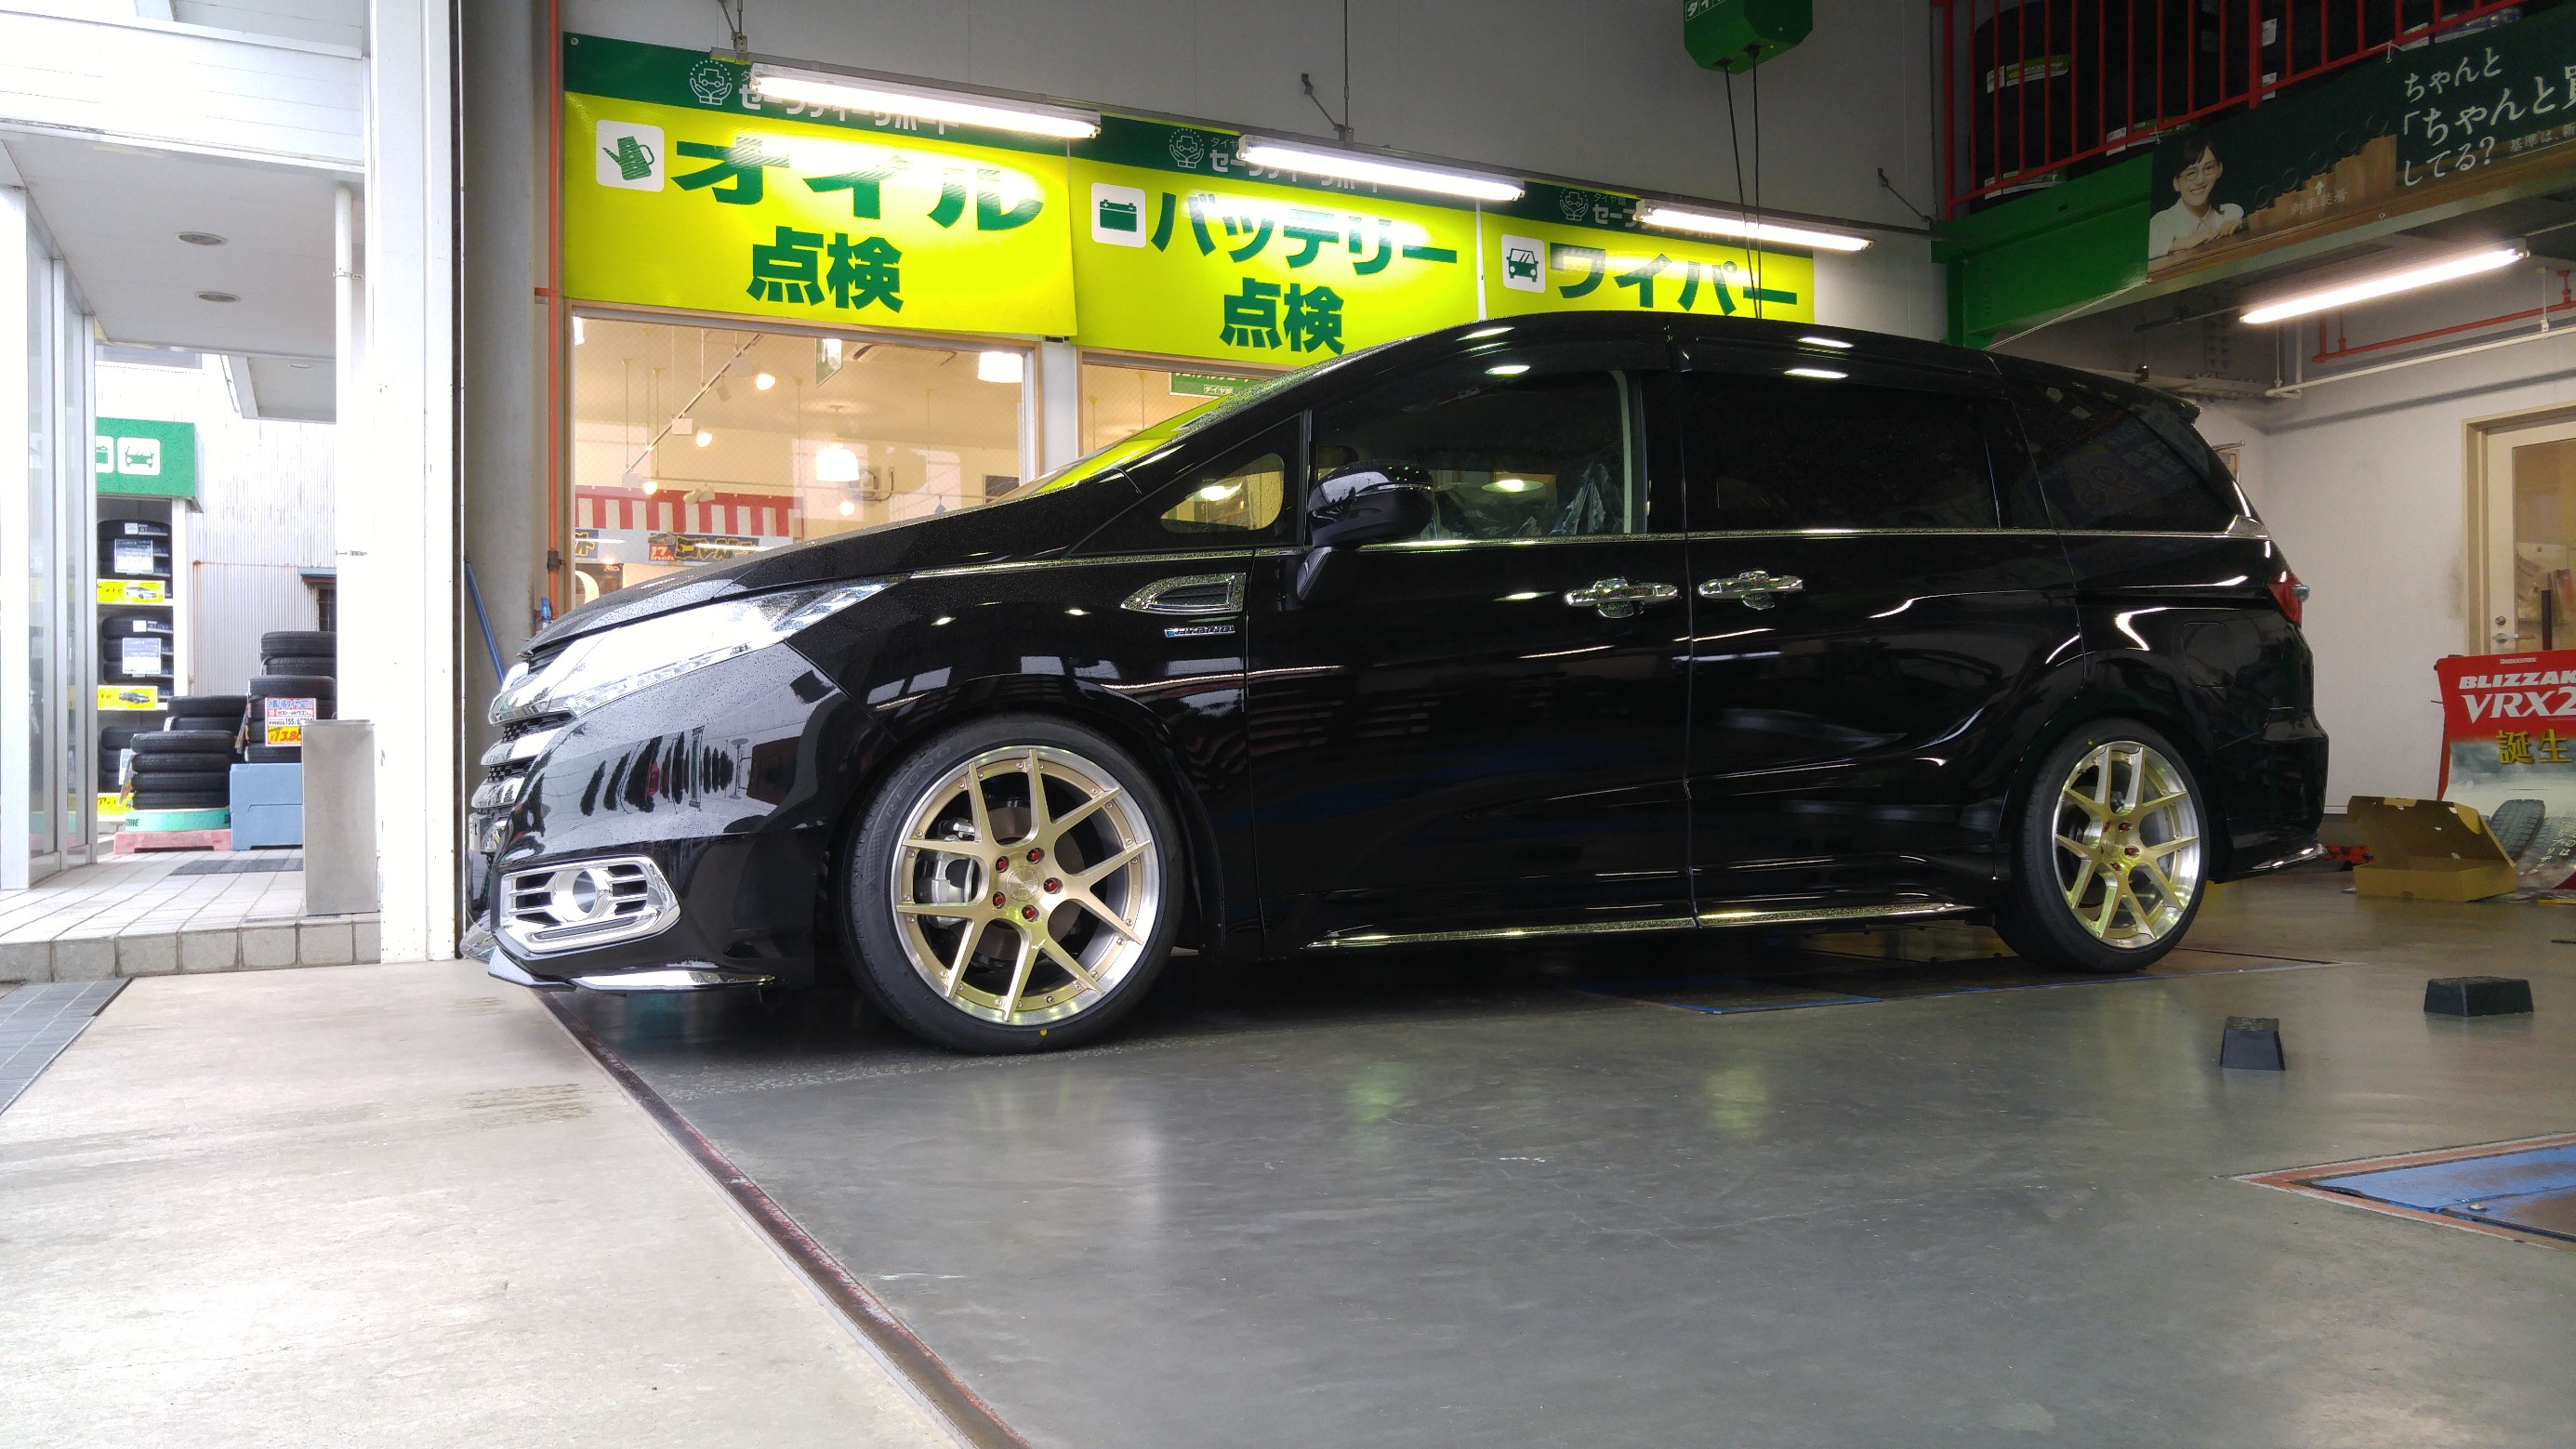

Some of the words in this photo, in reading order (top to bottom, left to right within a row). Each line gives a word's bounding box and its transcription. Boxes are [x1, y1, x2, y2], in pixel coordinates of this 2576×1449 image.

[2404, 46, 2502, 101] ちゃんと
[670, 135, 1045, 231] オイル
[1151, 191, 1458, 276] バッテリー
[746, 226, 905, 313] 点検
[1550, 242, 1797, 315] ワイパー
[1220, 277, 1345, 355] 点検
[651, 546, 667, 555] 17
[2459, 670, 2576, 690] BLIZZAK
[2461, 686, 2576, 725] VRX2
[2496, 728, 2572, 766] 誕生
